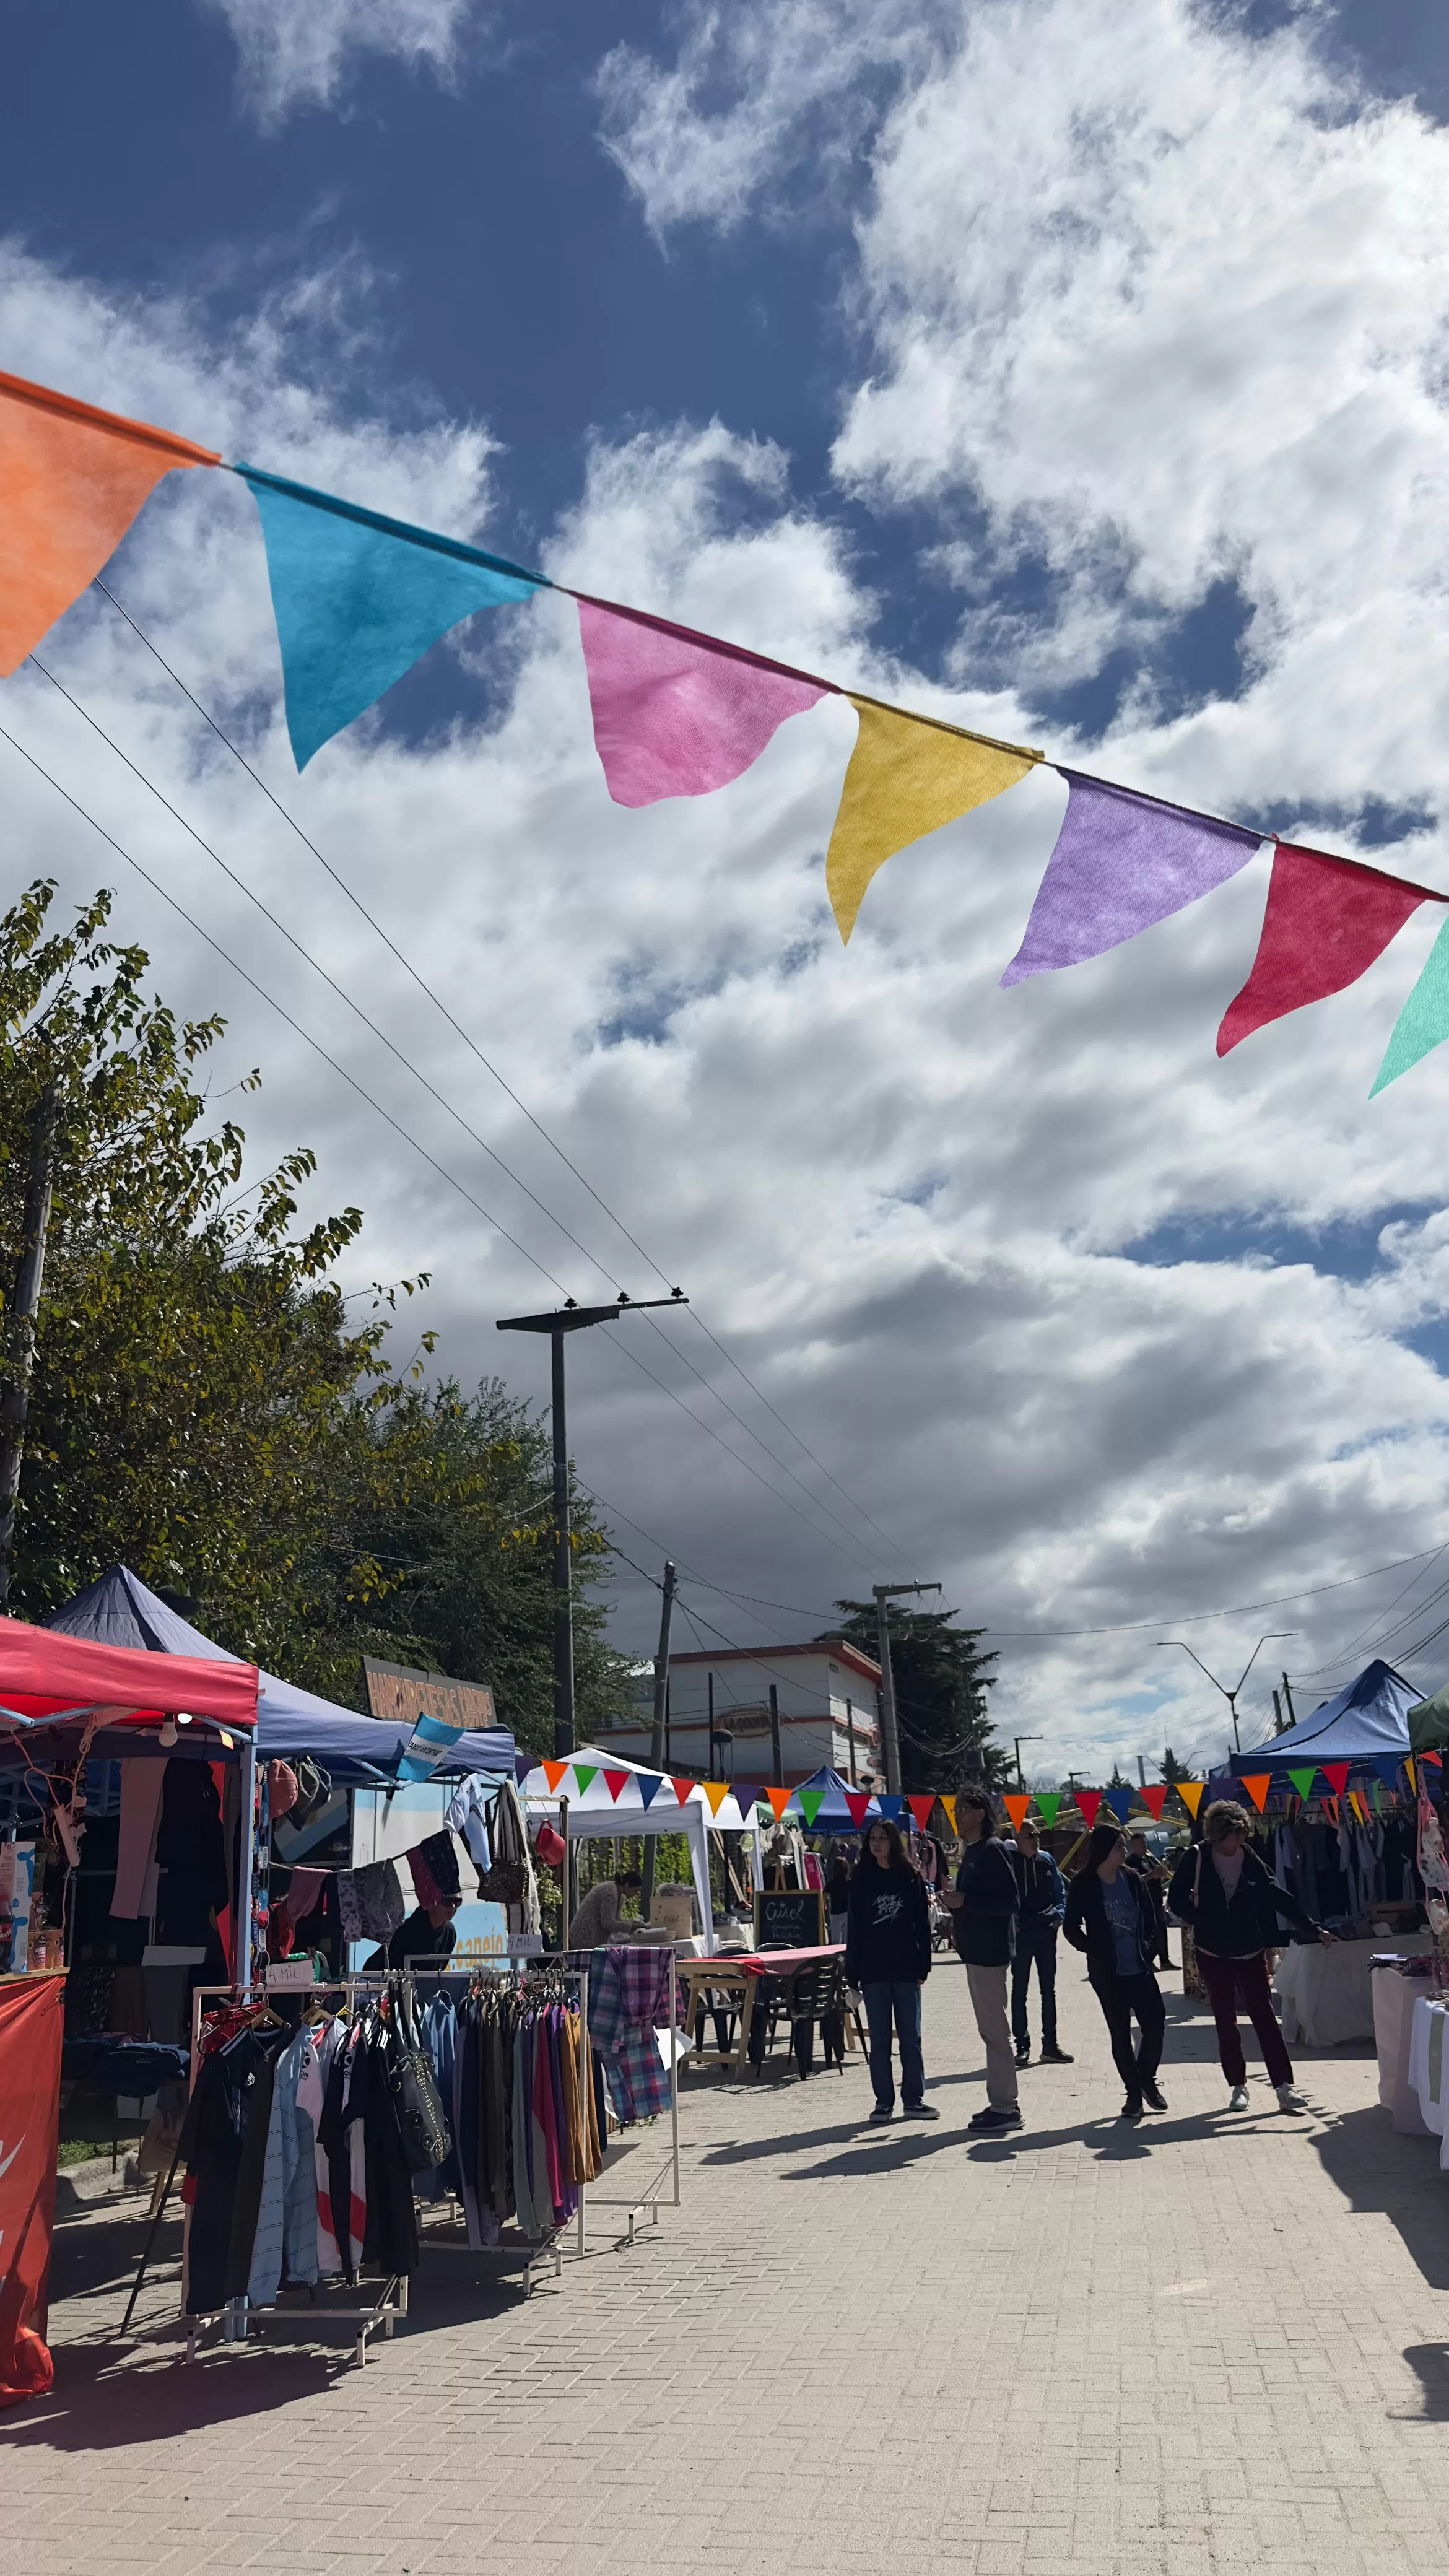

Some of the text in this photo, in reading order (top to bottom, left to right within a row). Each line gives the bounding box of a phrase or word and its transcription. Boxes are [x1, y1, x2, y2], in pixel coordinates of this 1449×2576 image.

[508, 1936, 532, 1950] 4 MIL
[269, 1967, 277, 1983] 4
[281, 1965, 298, 1980] MIL
